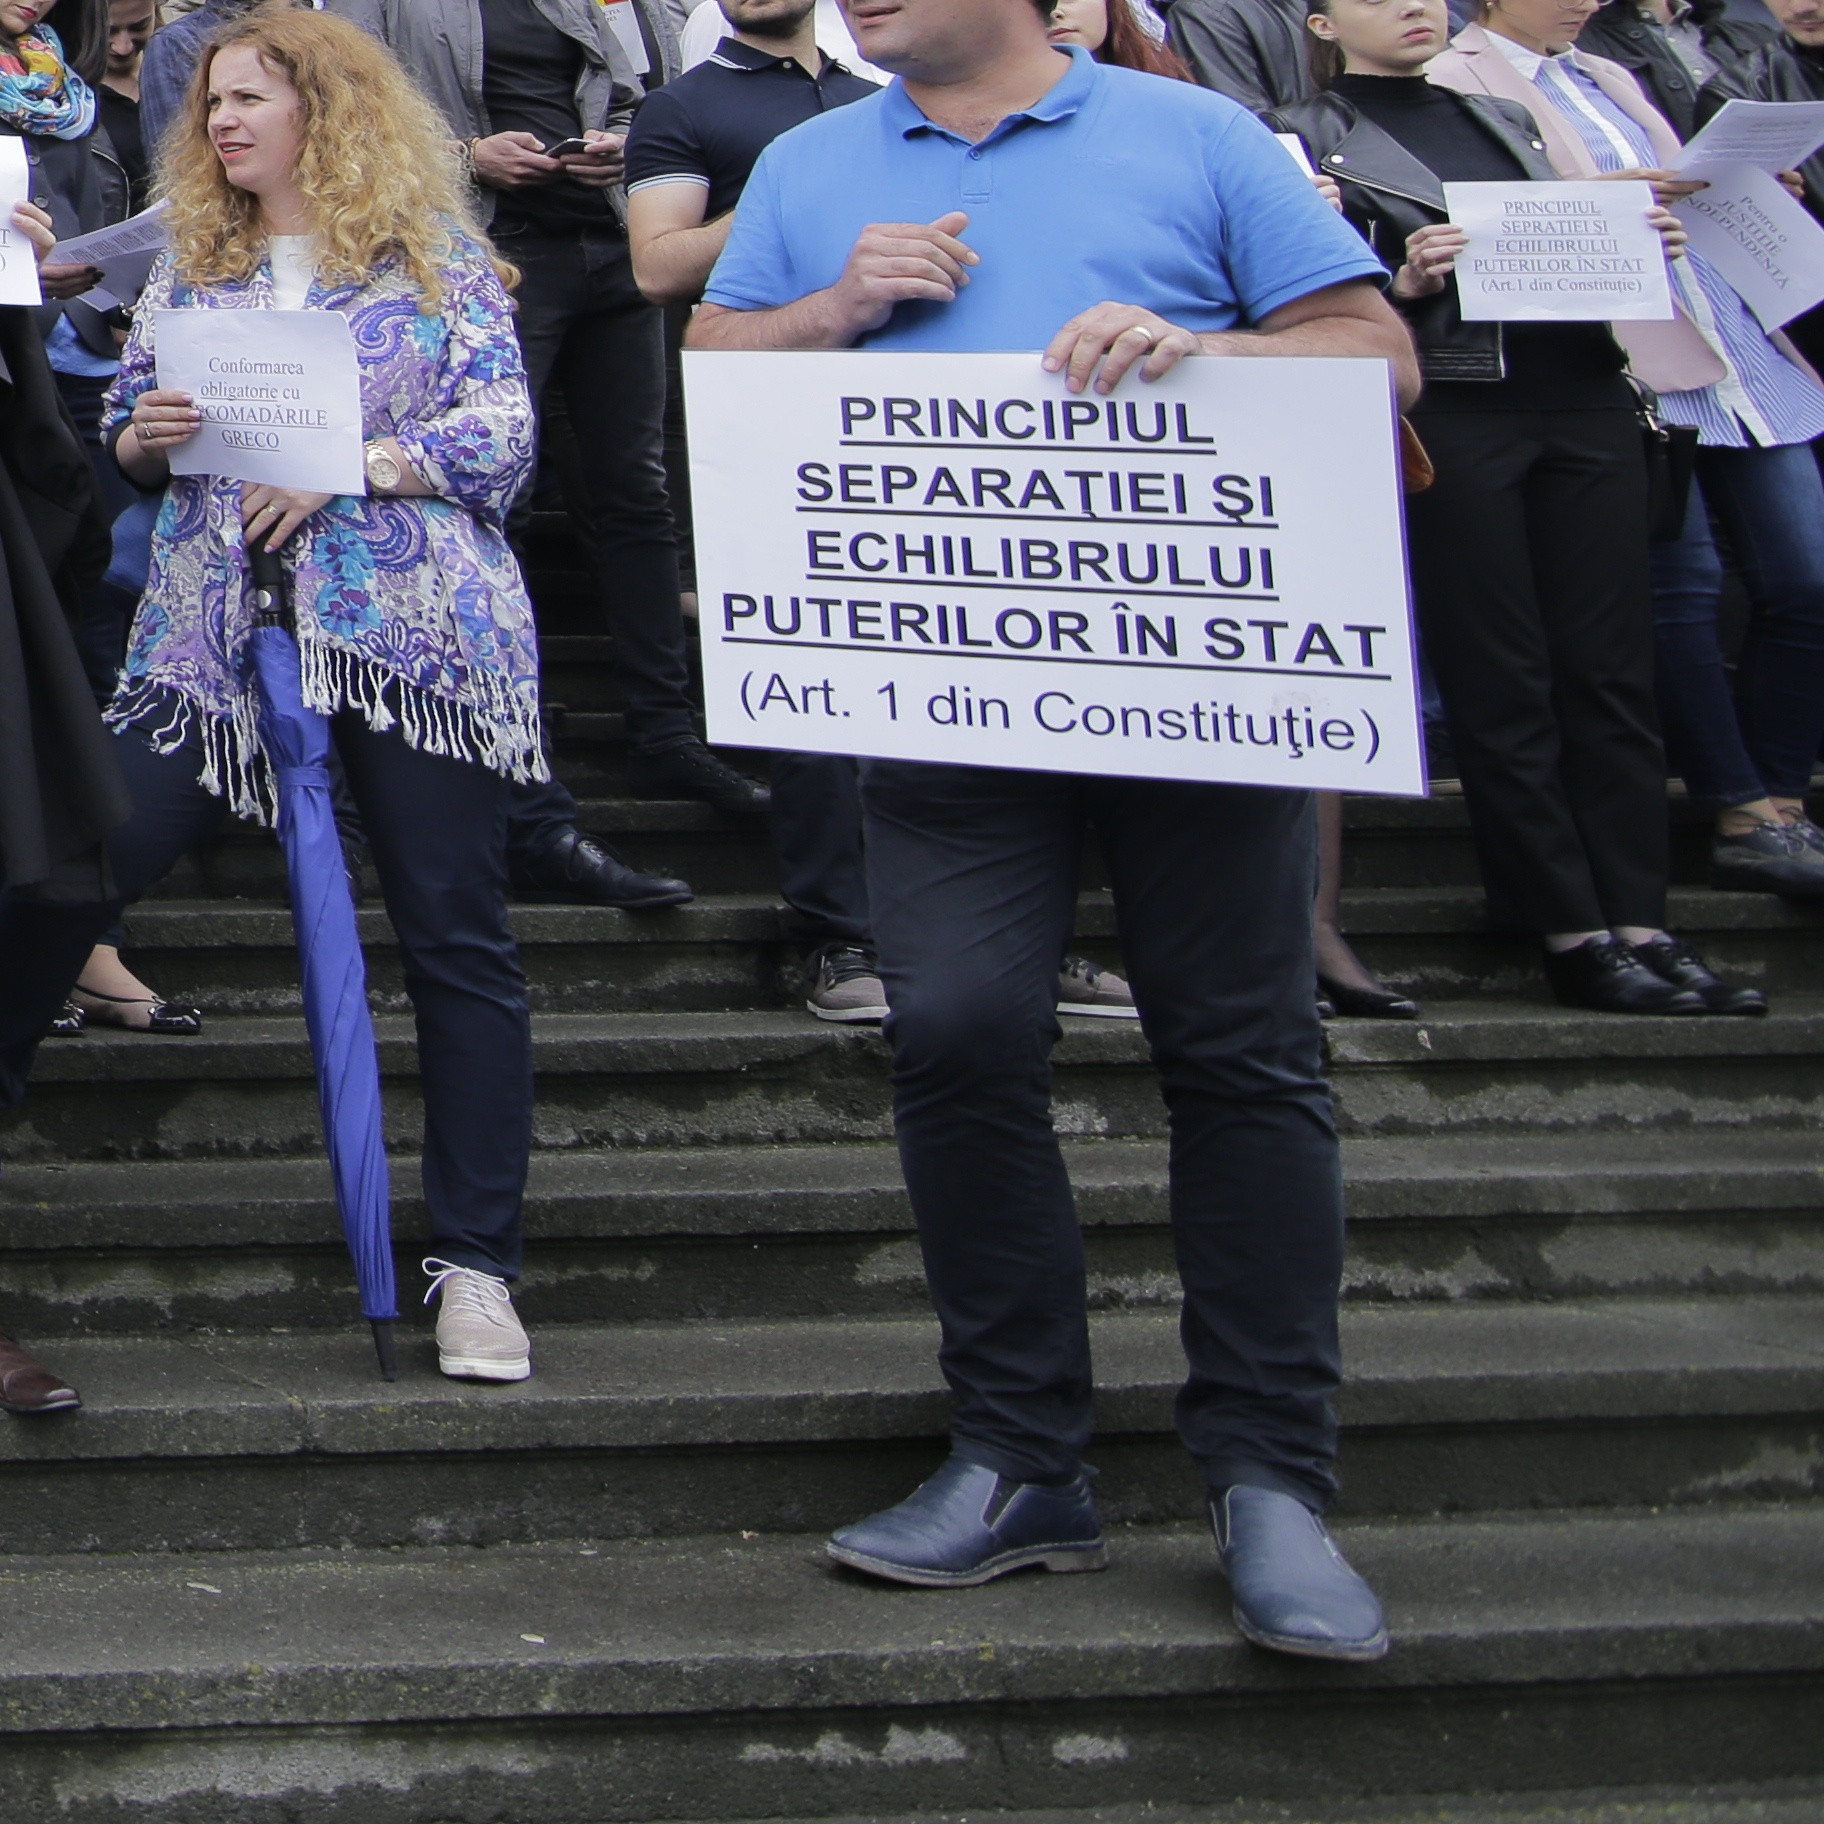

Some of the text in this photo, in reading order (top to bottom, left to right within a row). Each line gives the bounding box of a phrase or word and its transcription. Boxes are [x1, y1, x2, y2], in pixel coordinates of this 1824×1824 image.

[1504, 201, 1600, 214] PRINCIPIUL
[1495, 239, 1619, 253] ECHILIBRULUI
[1473, 256, 1645, 272] PUTERILOR ÎN STAT
[1529, 279, 1552, 291] din
[209, 357, 304, 375] Conformarea
[201, 382, 300, 400] obligatorie cu
[196, 405, 328, 426] ECOMADĂRILE
[840, 396, 1214, 444] PRINCIPIUL
[222, 430, 279, 448] GRECO
[807, 529, 1276, 590] ECHILIBRULUI
[722, 593, 1388, 668] PUTERILOR ÎN STAT
[739, 670, 850, 722] (Art.
[878, 683, 900, 721] 1
[926, 685, 1011, 730] din
